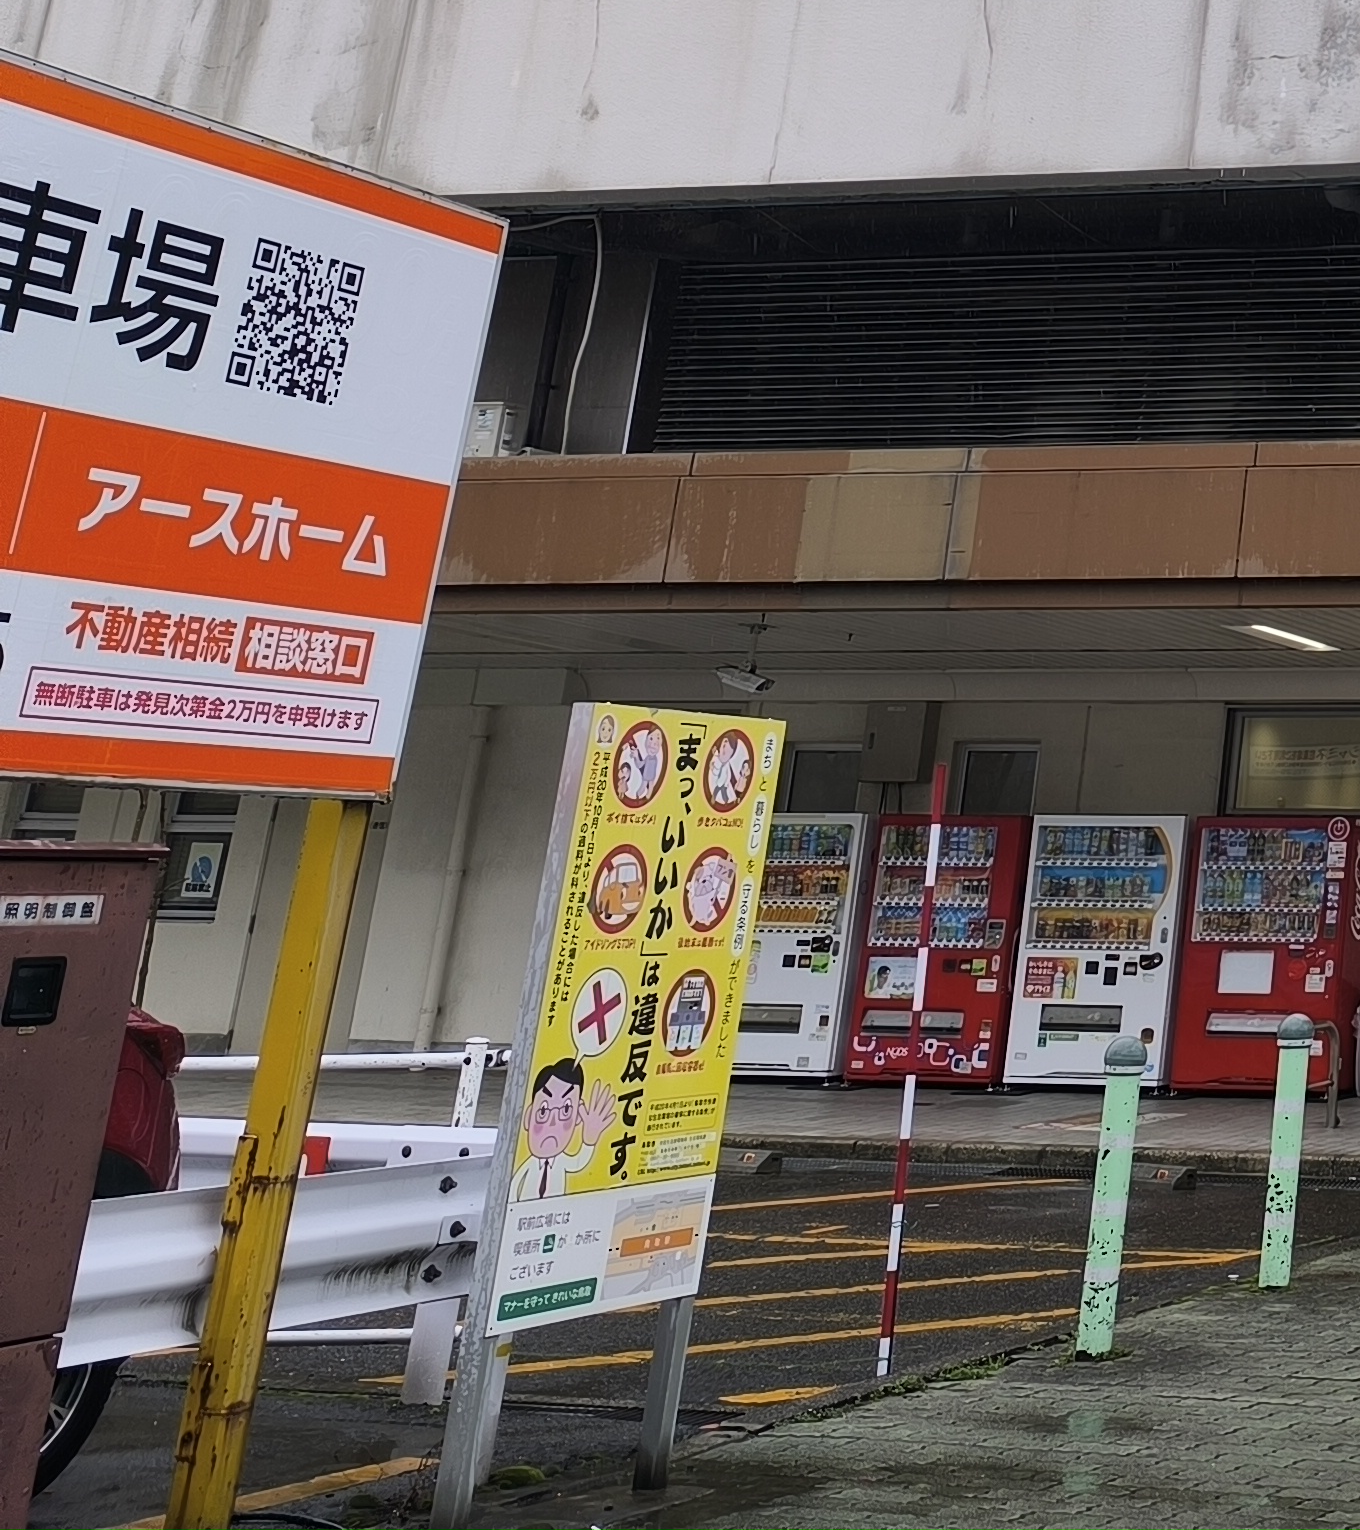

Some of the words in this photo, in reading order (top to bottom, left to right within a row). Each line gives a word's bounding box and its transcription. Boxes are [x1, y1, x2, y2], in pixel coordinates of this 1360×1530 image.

[78, 466, 388, 577] アースホーム
[65, 600, 238, 666] 不動産相続
[244, 625, 369, 681] 相談窓口
[32, 680, 370, 733] 無断駐車は発見次第金2万円を申受けます
[3, 901, 96, 920] 照明制御盤
[516, 1211, 571, 1232] 駅前広場には
[509, 1260, 555, 1281] ございます
